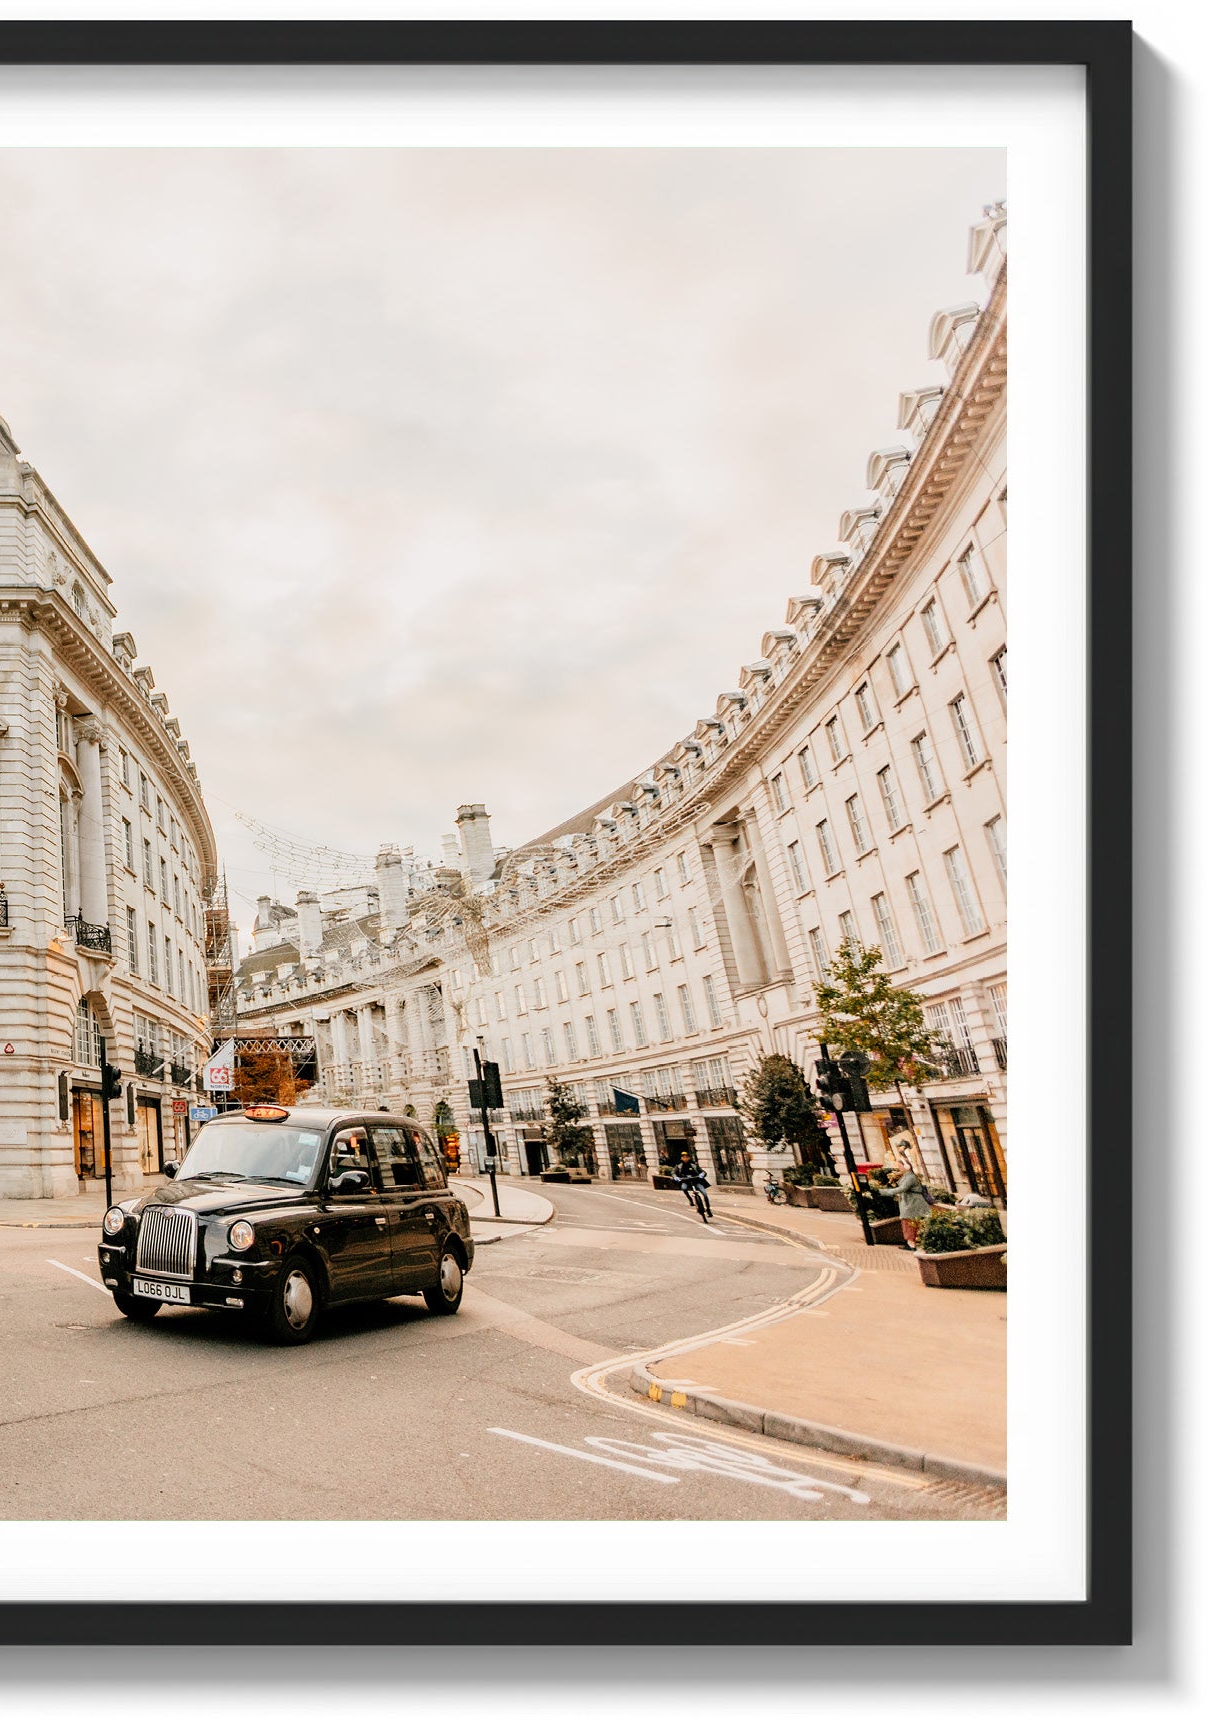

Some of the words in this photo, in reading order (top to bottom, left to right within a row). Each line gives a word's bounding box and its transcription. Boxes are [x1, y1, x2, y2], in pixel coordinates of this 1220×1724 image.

[211, 1070, 228, 1083] 66
[174, 1103, 185, 1112] 66
[252, 1109, 276, 1117] TAXI
[137, 1281, 162, 1296] LO66
[165, 1286, 185, 1300] OJL
